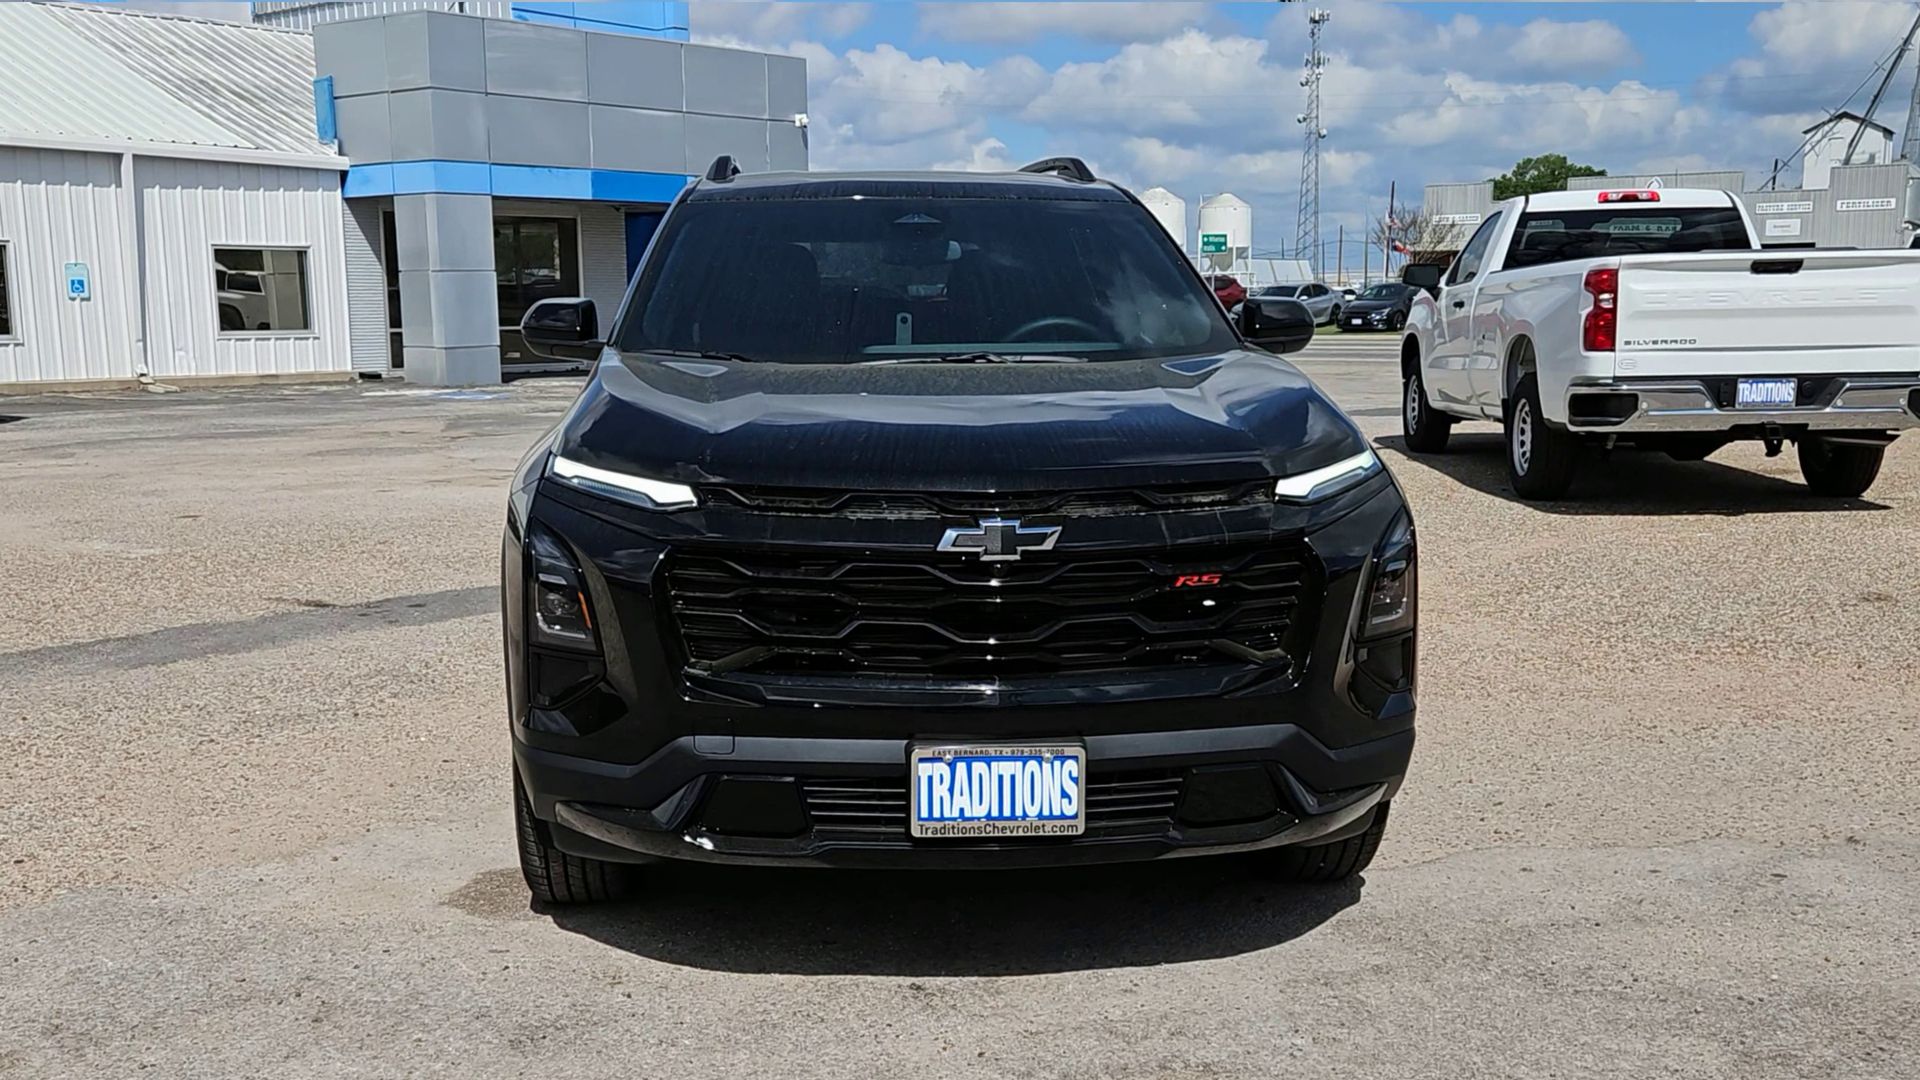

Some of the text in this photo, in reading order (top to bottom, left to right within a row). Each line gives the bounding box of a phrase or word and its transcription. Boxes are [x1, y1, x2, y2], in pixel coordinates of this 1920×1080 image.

[1839, 200, 1893, 209] FERTILIZER
[1613, 224, 1640, 232] FARM
[1639, 286, 1910, 308] CHEVROLET
[1623, 338, 1698, 346] SILVERADO
[1738, 381, 1795, 403] TRADITIONS
[1175, 573, 1223, 587] RS
[917, 758, 1079, 818] TRADITIONS
[918, 821, 1079, 836] TraditionsChevrolet.com
